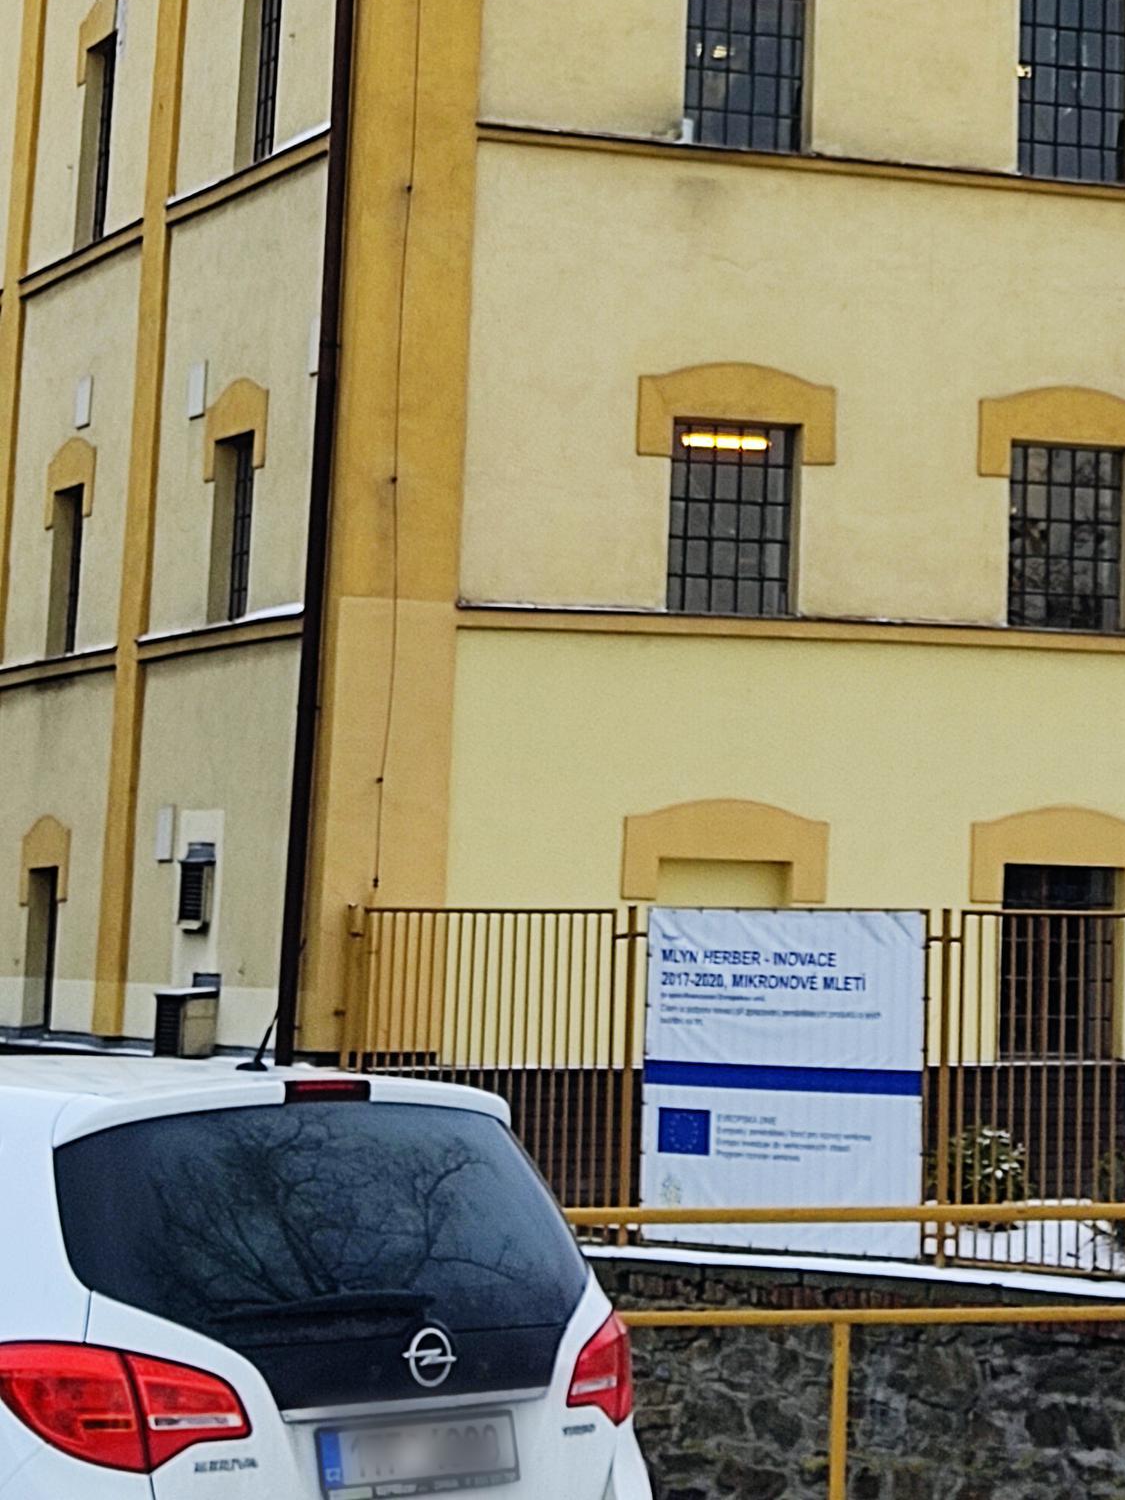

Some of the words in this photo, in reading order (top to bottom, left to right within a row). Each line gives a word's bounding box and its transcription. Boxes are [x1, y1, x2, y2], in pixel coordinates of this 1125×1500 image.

[703, 951, 760, 966] HERBER
[773, 952, 837, 967] INOVACE
[731, 973, 818, 991] MIKRONOVÉ
